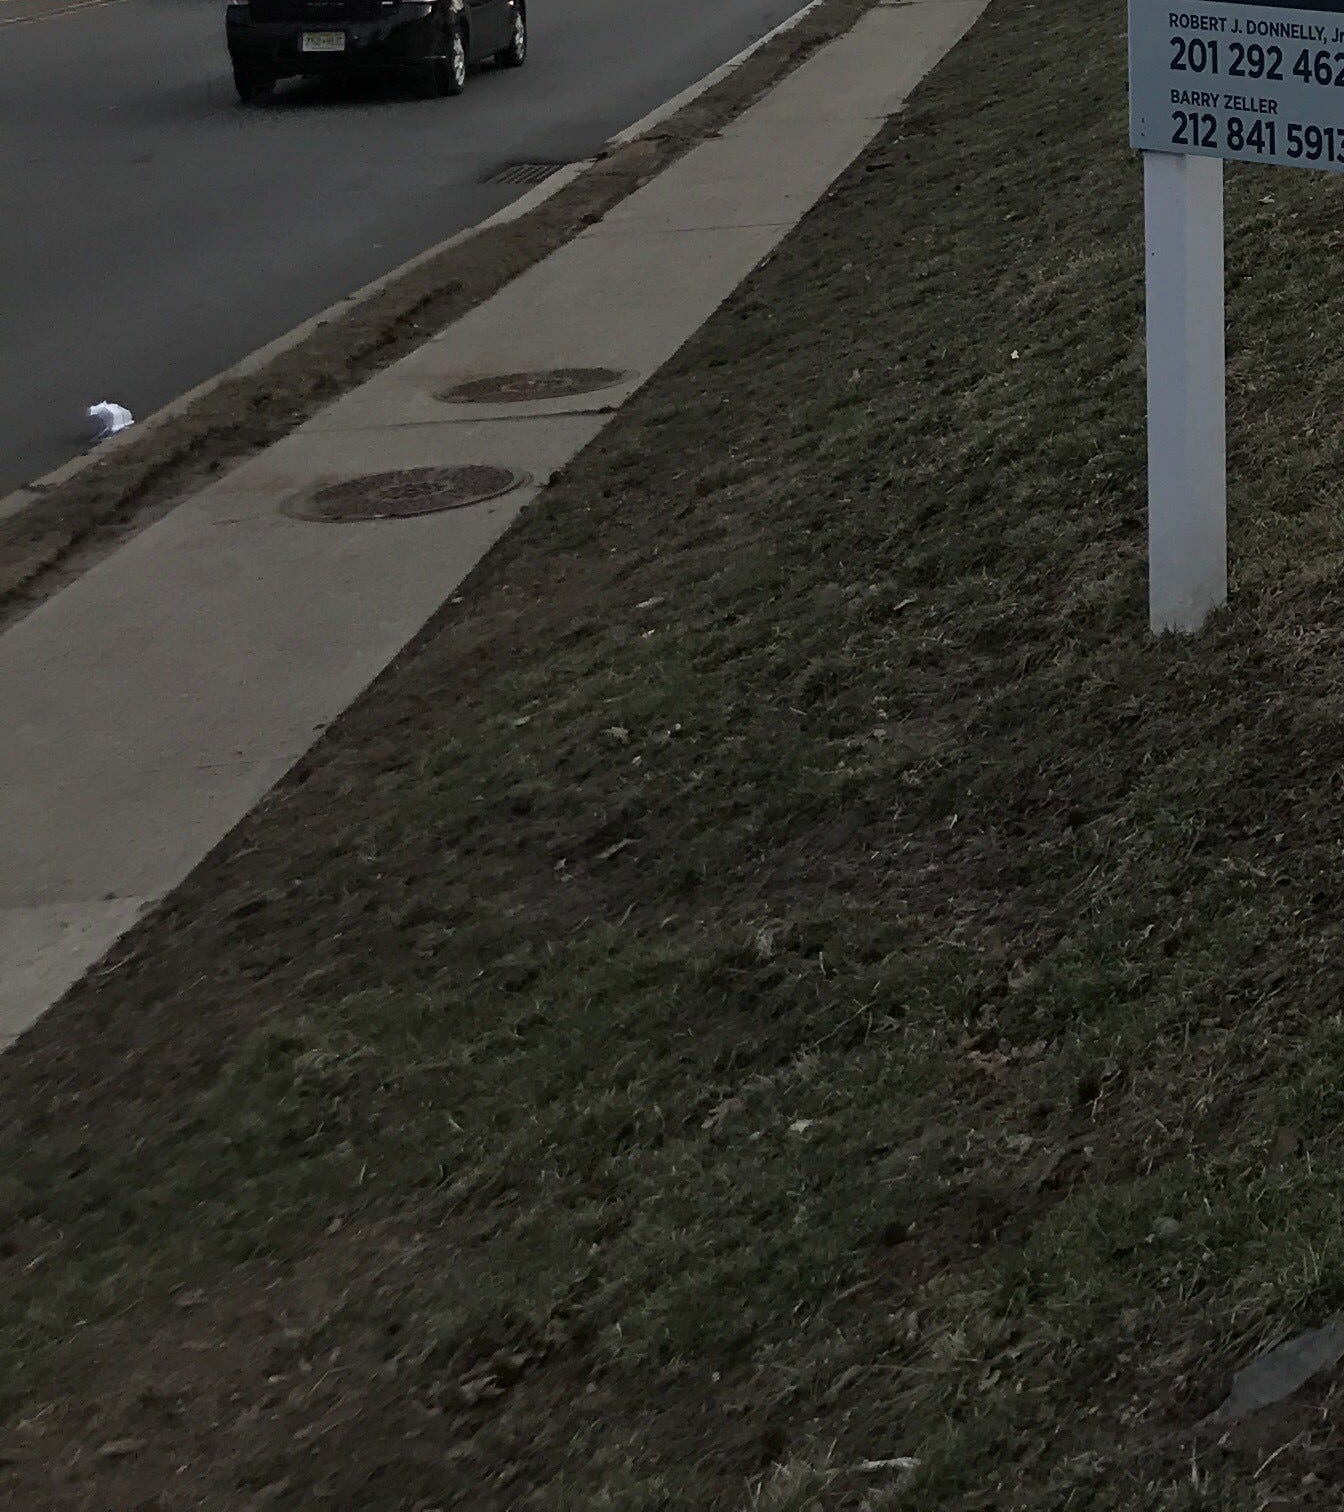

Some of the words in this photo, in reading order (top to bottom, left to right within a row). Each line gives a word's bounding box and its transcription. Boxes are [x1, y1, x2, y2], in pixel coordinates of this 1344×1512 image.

[1169, 13, 1227, 32] ROBERT
[1231, 19, 1242, 33] J.
[1247, 20, 1327, 44] DONNELLY,
[1170, 37, 1218, 74] 201
[1229, 43, 1283, 80] 292
[1171, 89, 1219, 107] BARRY
[1224, 95, 1277, 114] ZELLER
[1172, 111, 1217, 148] 212
[1227, 117, 1275, 155] 841
